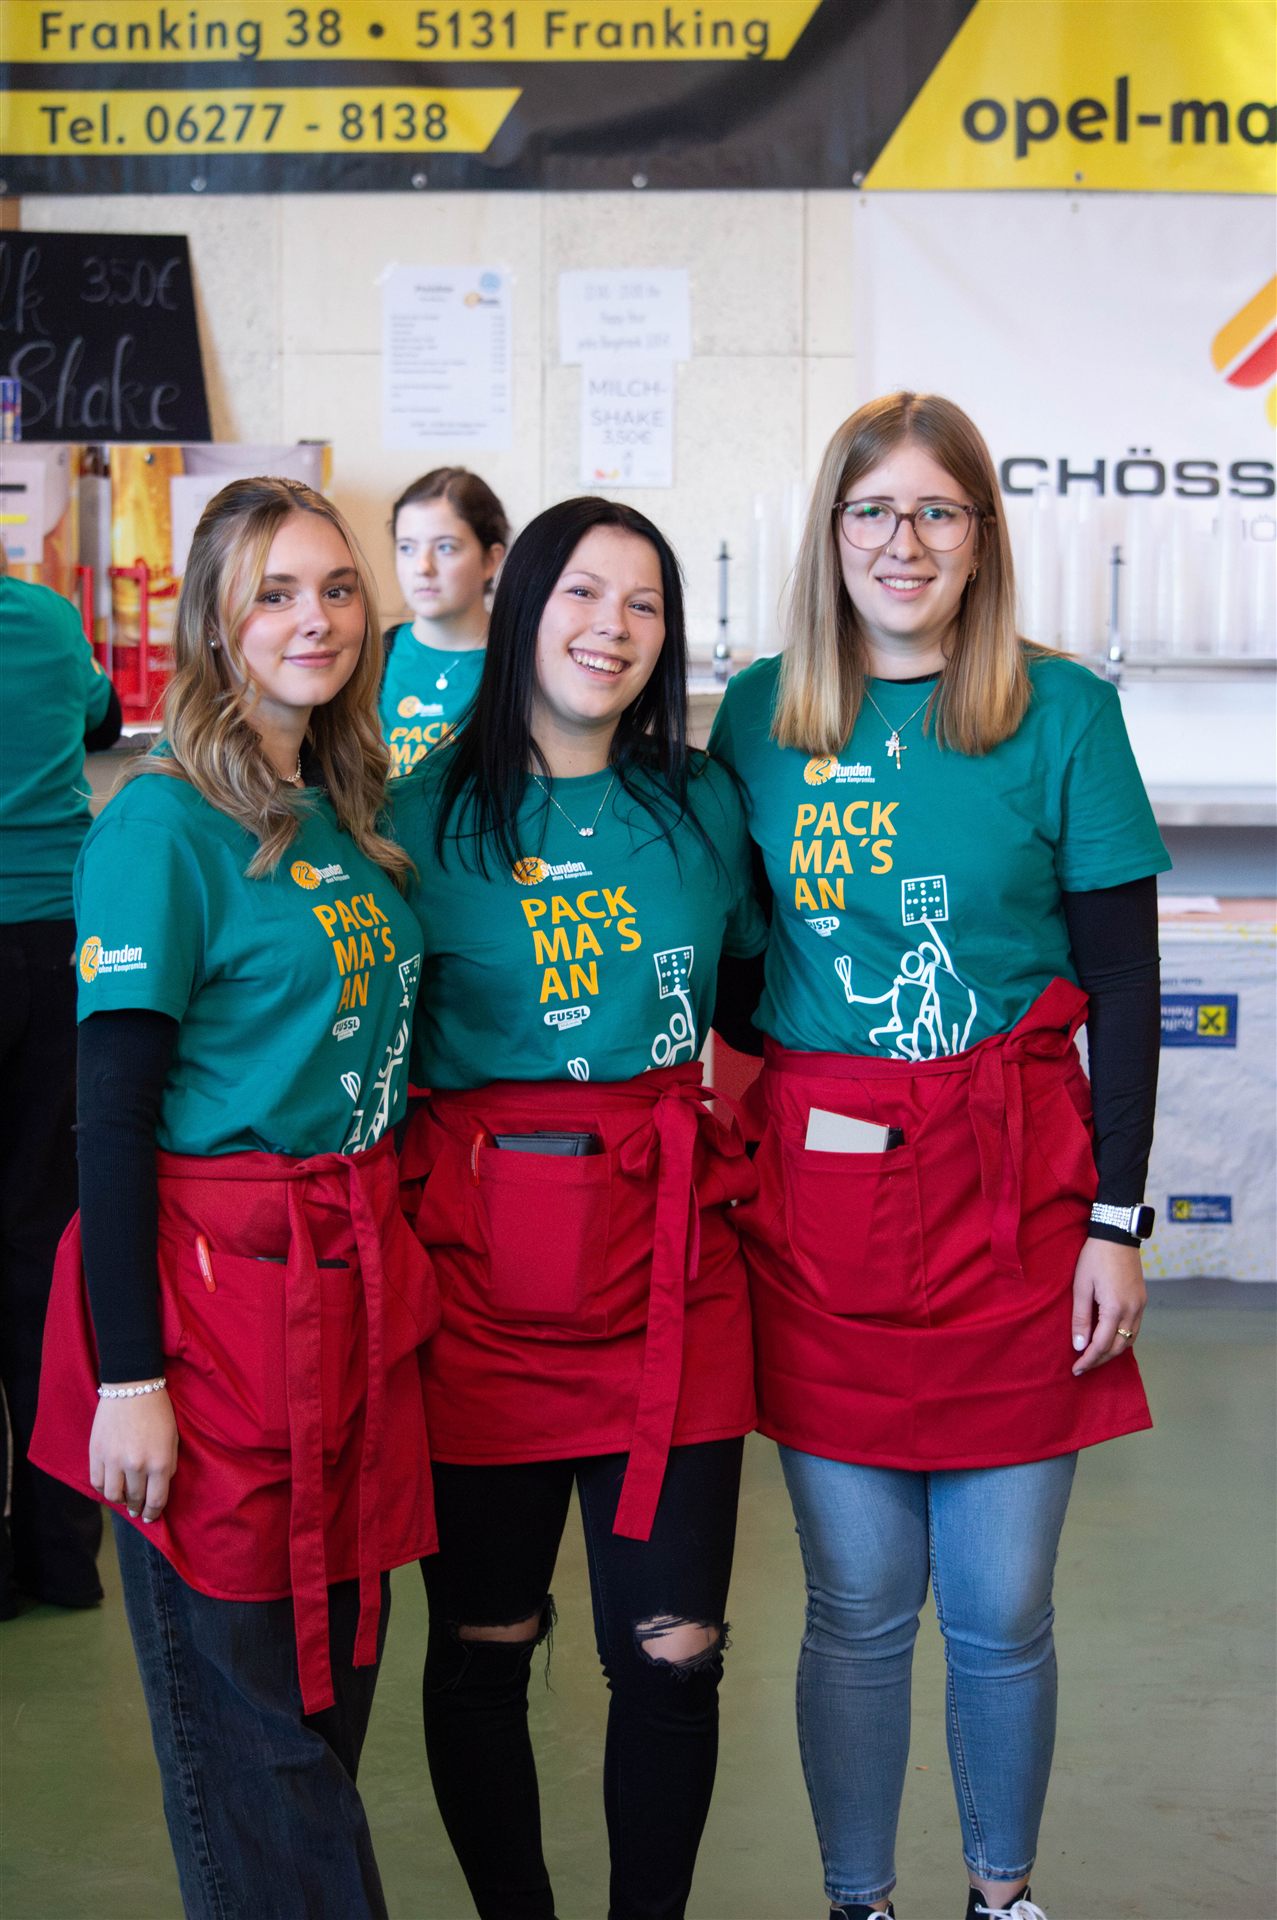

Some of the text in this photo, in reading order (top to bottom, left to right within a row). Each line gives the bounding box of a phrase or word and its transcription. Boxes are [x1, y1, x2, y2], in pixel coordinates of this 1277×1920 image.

[39, 9, 771, 60] Franking 38 5131 Franking
[40, 106, 125, 144] Tel.
[145, 104, 286, 143] 06277
[340, 102, 448, 142] 8138
[962, 75, 1277, 160] opel-ma
[9, 334, 182, 433] Shake
[591, 408, 665, 428] SHAKE
[1000, 447, 1276, 498] CHÖSS
[829, 762, 872, 777] Stunden
[794, 801, 899, 837] PACK
[296, 866, 314, 881] 72
[540, 861, 586, 876] Stunden
[520, 886, 637, 927] PACK
[795, 878, 846, 911] AN
[312, 893, 388, 938] PACK
[84, 944, 99, 969] 72
[337, 971, 369, 1014] AN
[539, 961, 599, 1004] AN
[335, 1019, 359, 1033] FUSSL
[549, 1008, 587, 1023] FUSSL
